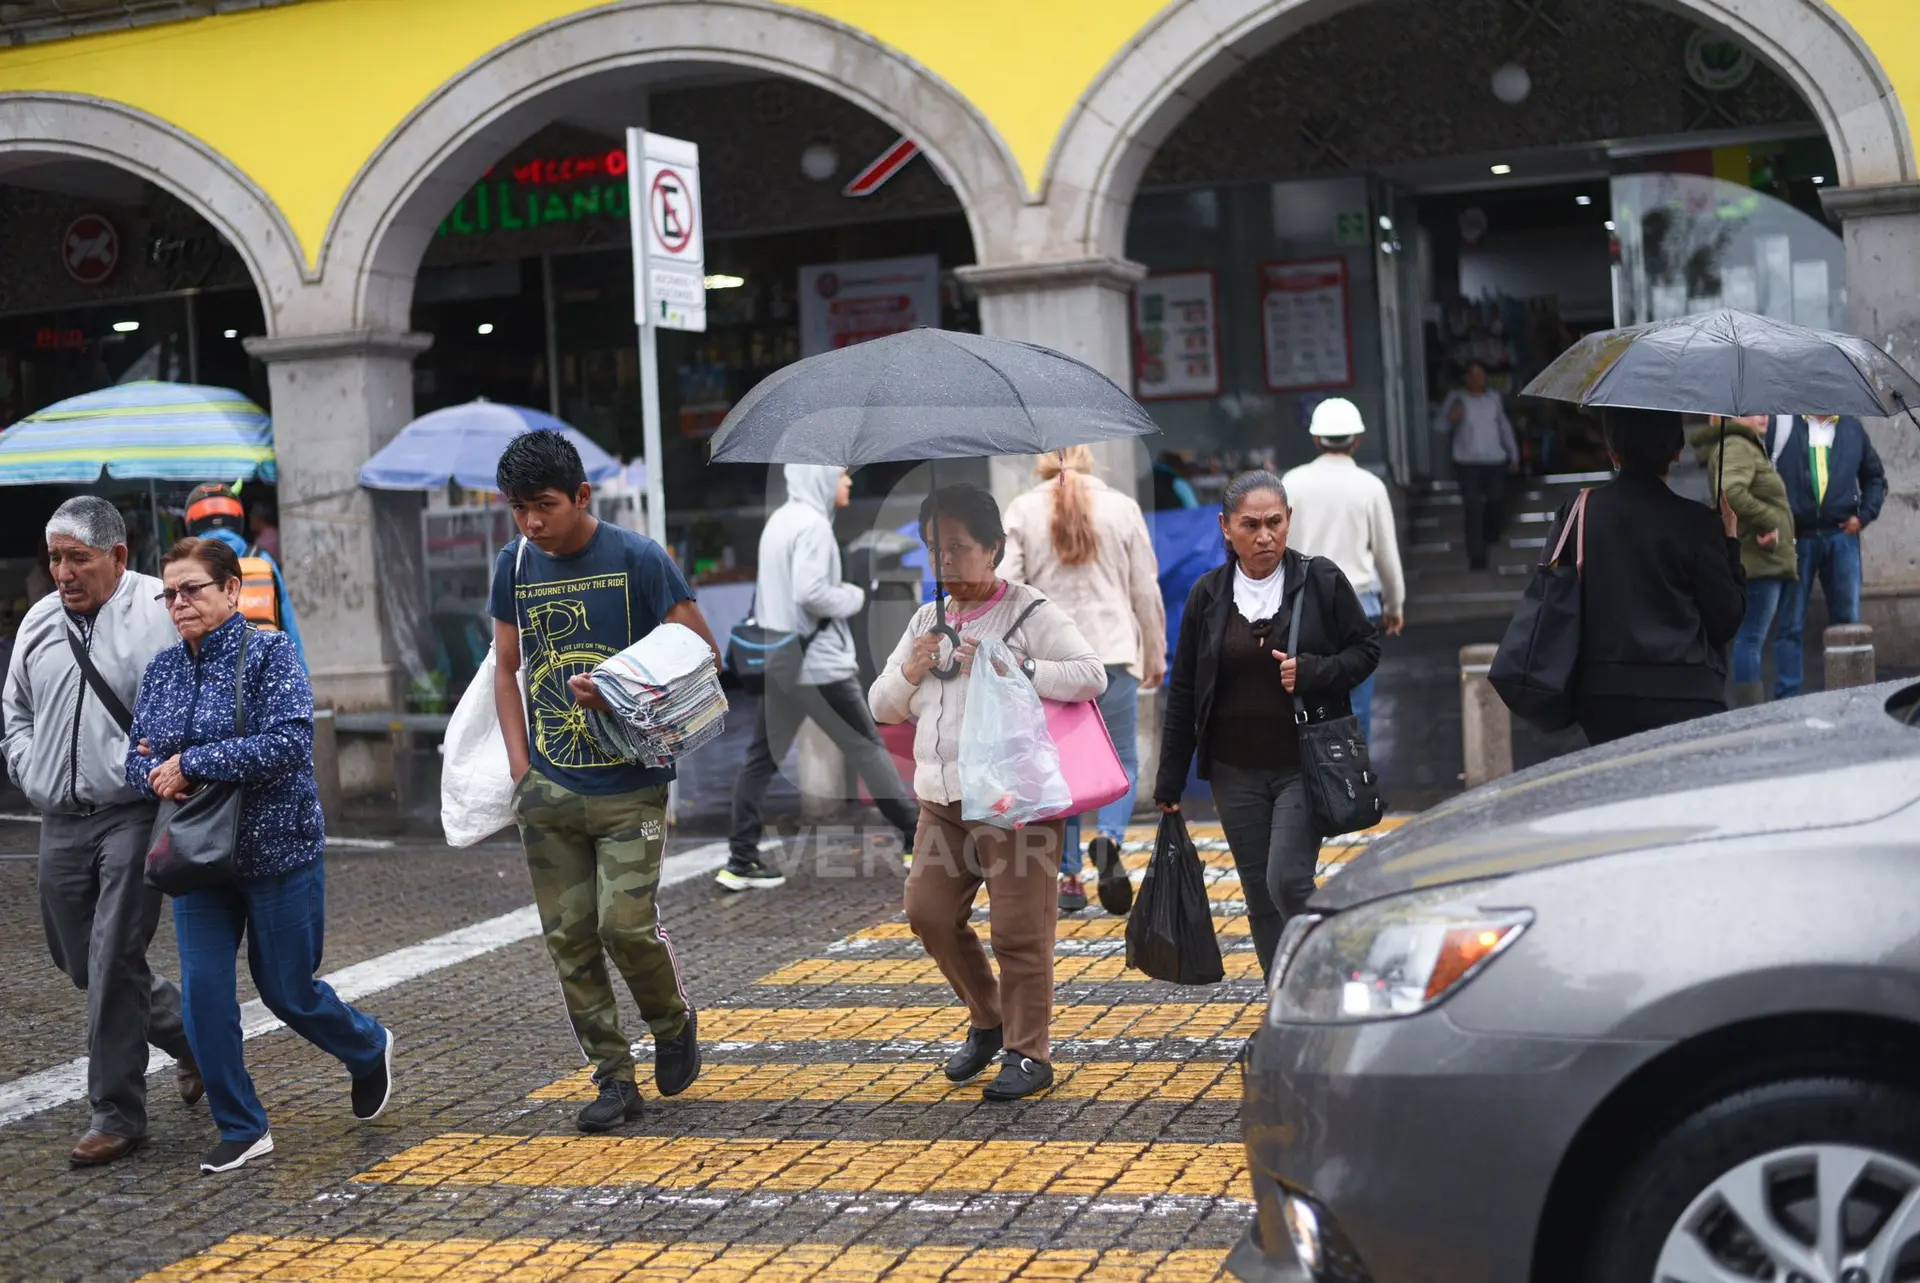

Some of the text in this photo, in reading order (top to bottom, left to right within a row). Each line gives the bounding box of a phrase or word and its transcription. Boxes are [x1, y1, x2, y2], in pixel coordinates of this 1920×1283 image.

[533, 586, 566, 597] JOURNEY
[567, 581, 591, 593] ENJOY
[592, 580, 606, 589] THE
[607, 577, 625, 588] RIDE
